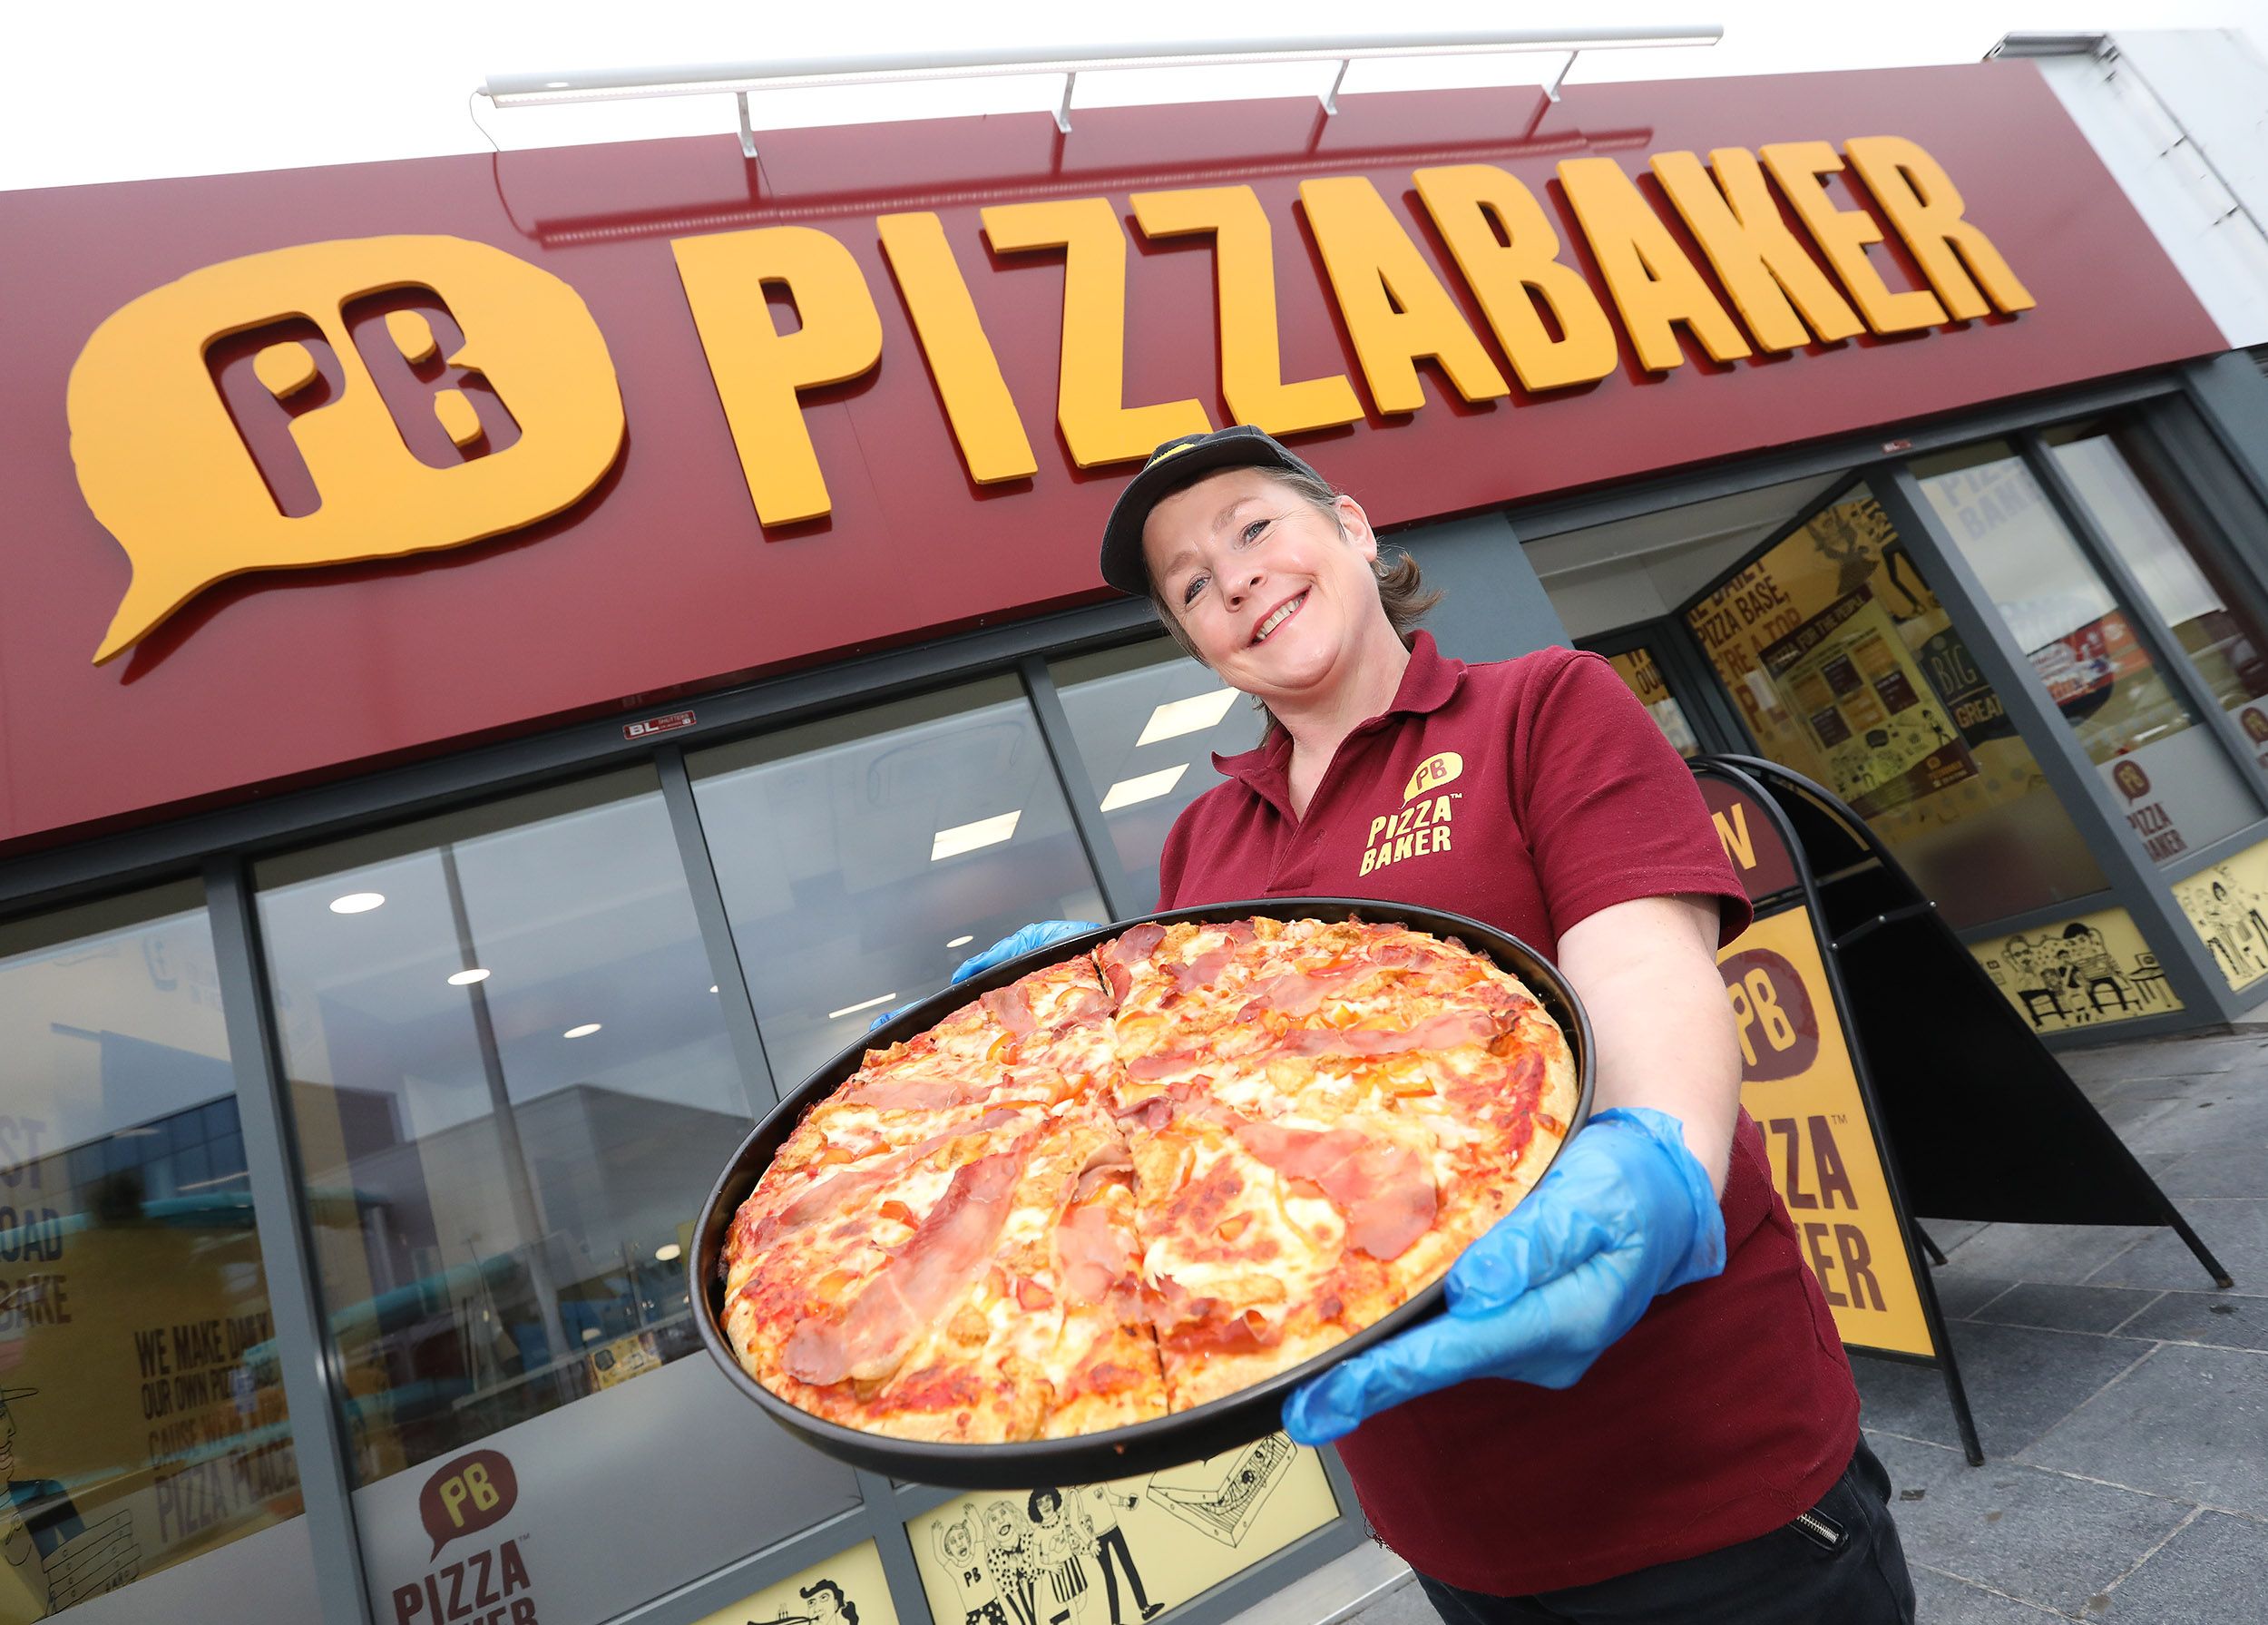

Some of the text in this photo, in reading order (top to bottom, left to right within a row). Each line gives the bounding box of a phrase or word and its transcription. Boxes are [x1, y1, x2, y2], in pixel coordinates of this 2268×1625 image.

[671, 134, 2038, 528] PIZZABAKER
[200, 280, 523, 518] PB
[1931, 643, 1979, 697] BIG
[1416, 759, 1447, 790] PB
[1359, 825, 1452, 877] BAKER
[1366, 795, 1452, 849] PIZZA
[1726, 967, 1796, 1067] PB
[1755, 1115, 1859, 1210] ZA
[1794, 1222, 1888, 1313] ER
[134, 1327, 171, 1378] WE
[172, 1319, 226, 1371] MAKE
[142, 1378, 173, 1420] OUR
[174, 1372, 210, 1412] OWN
[439, 1462, 499, 1528] PB
[393, 1540, 531, 1625] PIZZA
[963, 1566, 982, 1588] PB
